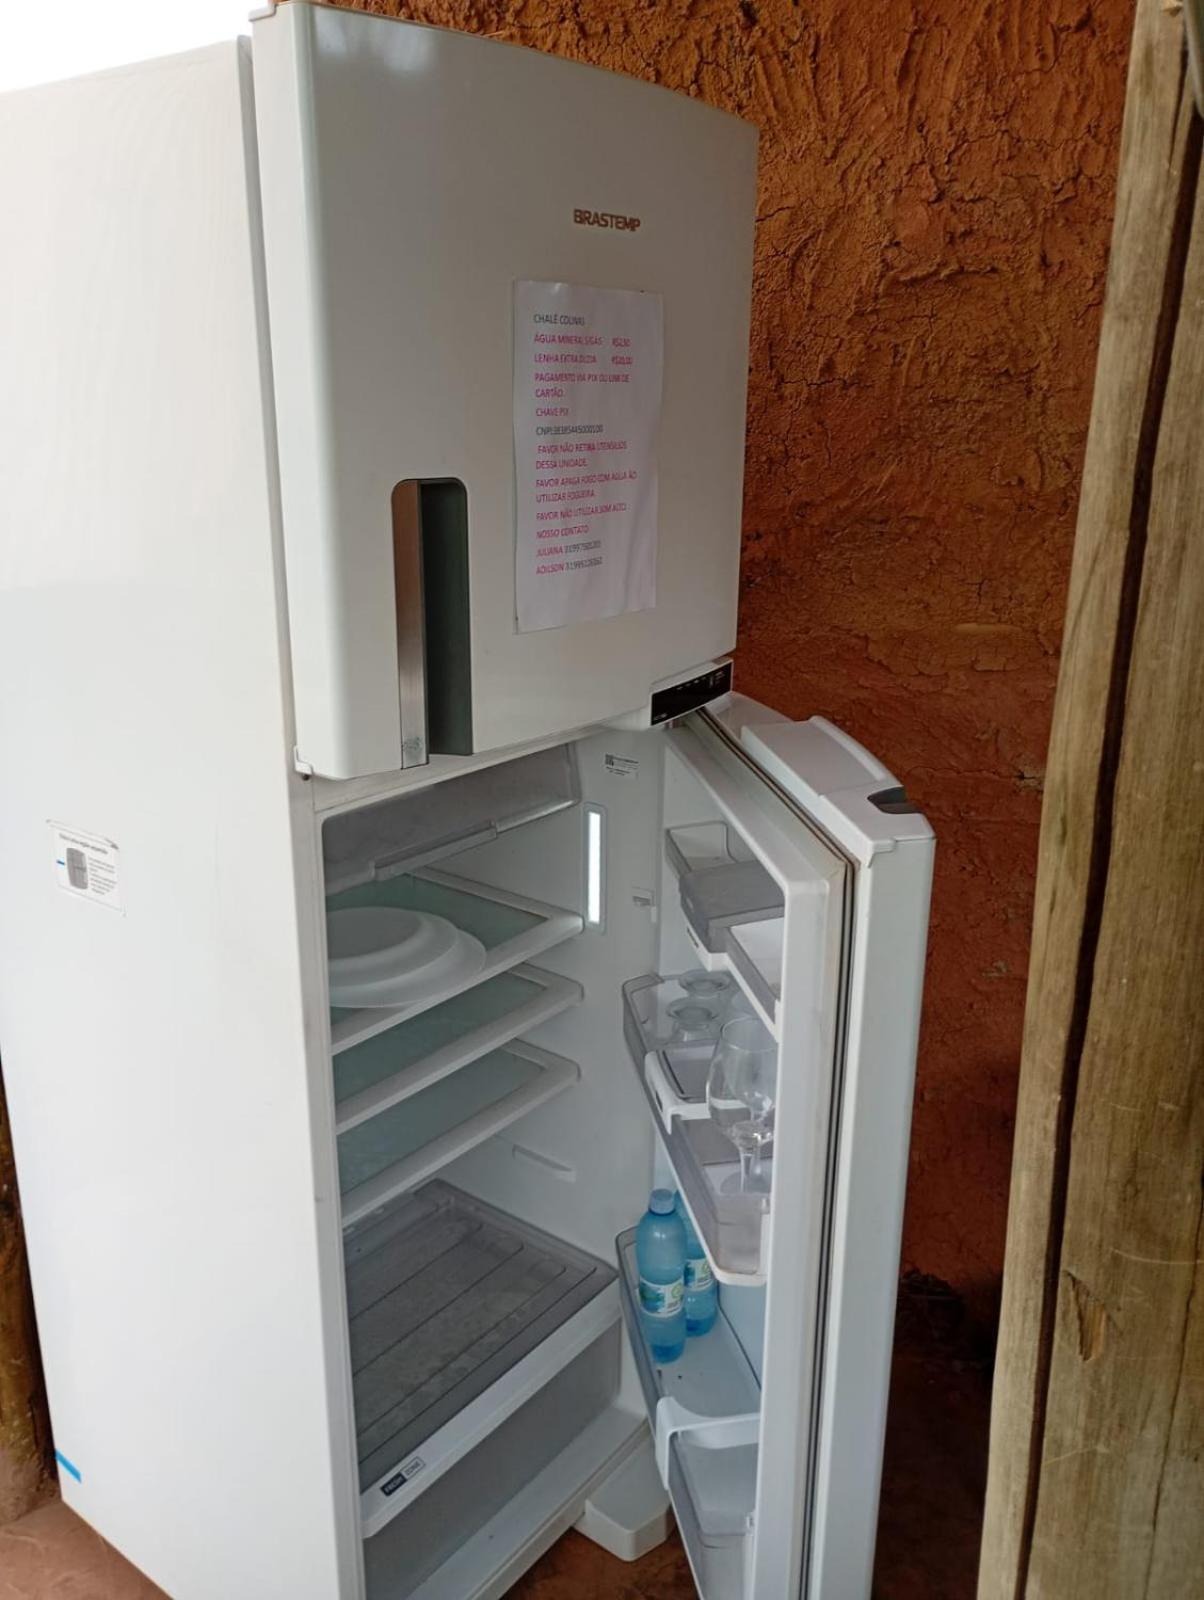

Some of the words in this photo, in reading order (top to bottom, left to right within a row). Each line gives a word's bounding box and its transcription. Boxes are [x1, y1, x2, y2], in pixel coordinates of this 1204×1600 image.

[573, 208, 641, 232] BRASTEMP
[534, 352, 559, 364] LENHA
[534, 372, 575, 382] PAGAMENTO
[587, 373, 598, 382] PIX
[535, 386, 564, 398] CARTÃO
[535, 407, 559, 417] CHAVE
[559, 407, 569, 417] PIX
[537, 444, 558, 454] FAVOR
[559, 441, 574, 453] NÃO
[535, 460, 557, 470] DESSA
[558, 457, 587, 468] UNIDADE
[536, 478, 559, 488] FAVOR
[536, 492, 565, 503] UTILIZAR
[536, 511, 559, 521] FAVOR
[536, 528, 560, 539] NOSSO
[561, 525, 589, 537] CONTATO
[536, 545, 563, 557] JULIANA
